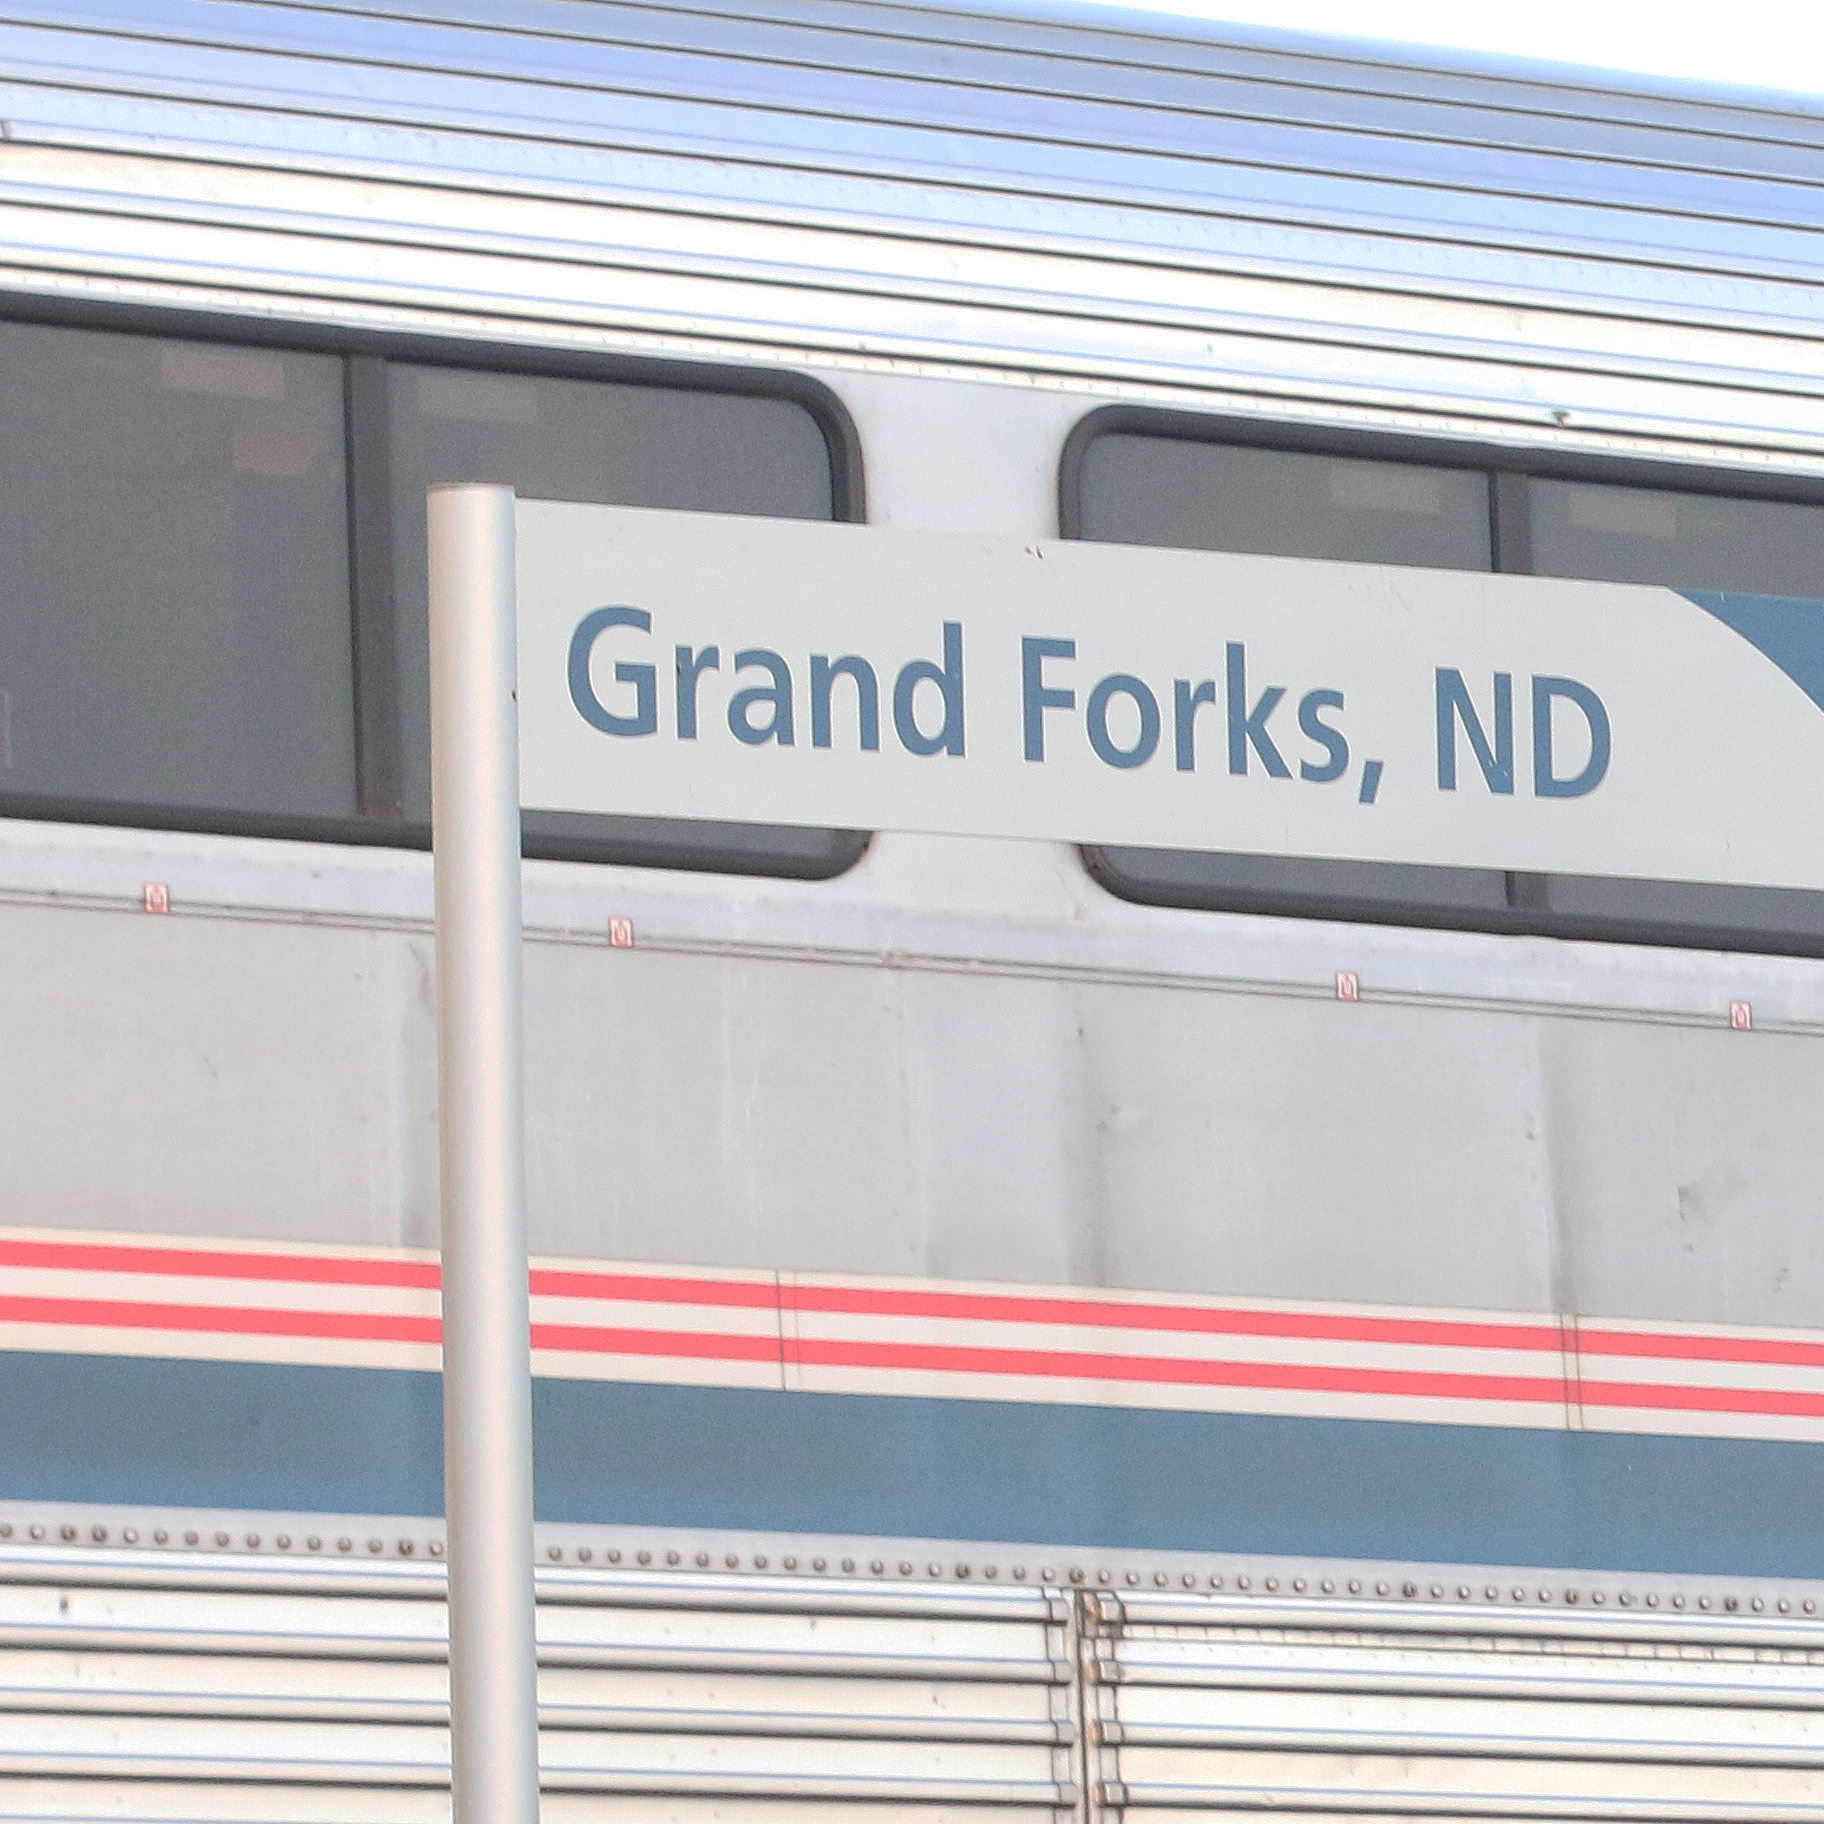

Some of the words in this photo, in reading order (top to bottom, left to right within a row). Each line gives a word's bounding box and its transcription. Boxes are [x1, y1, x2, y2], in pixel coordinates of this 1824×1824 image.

[567, 605, 966, 758] Grand
[1021, 634, 1384, 805] Forks,
[1433, 666, 1612, 799] ND
